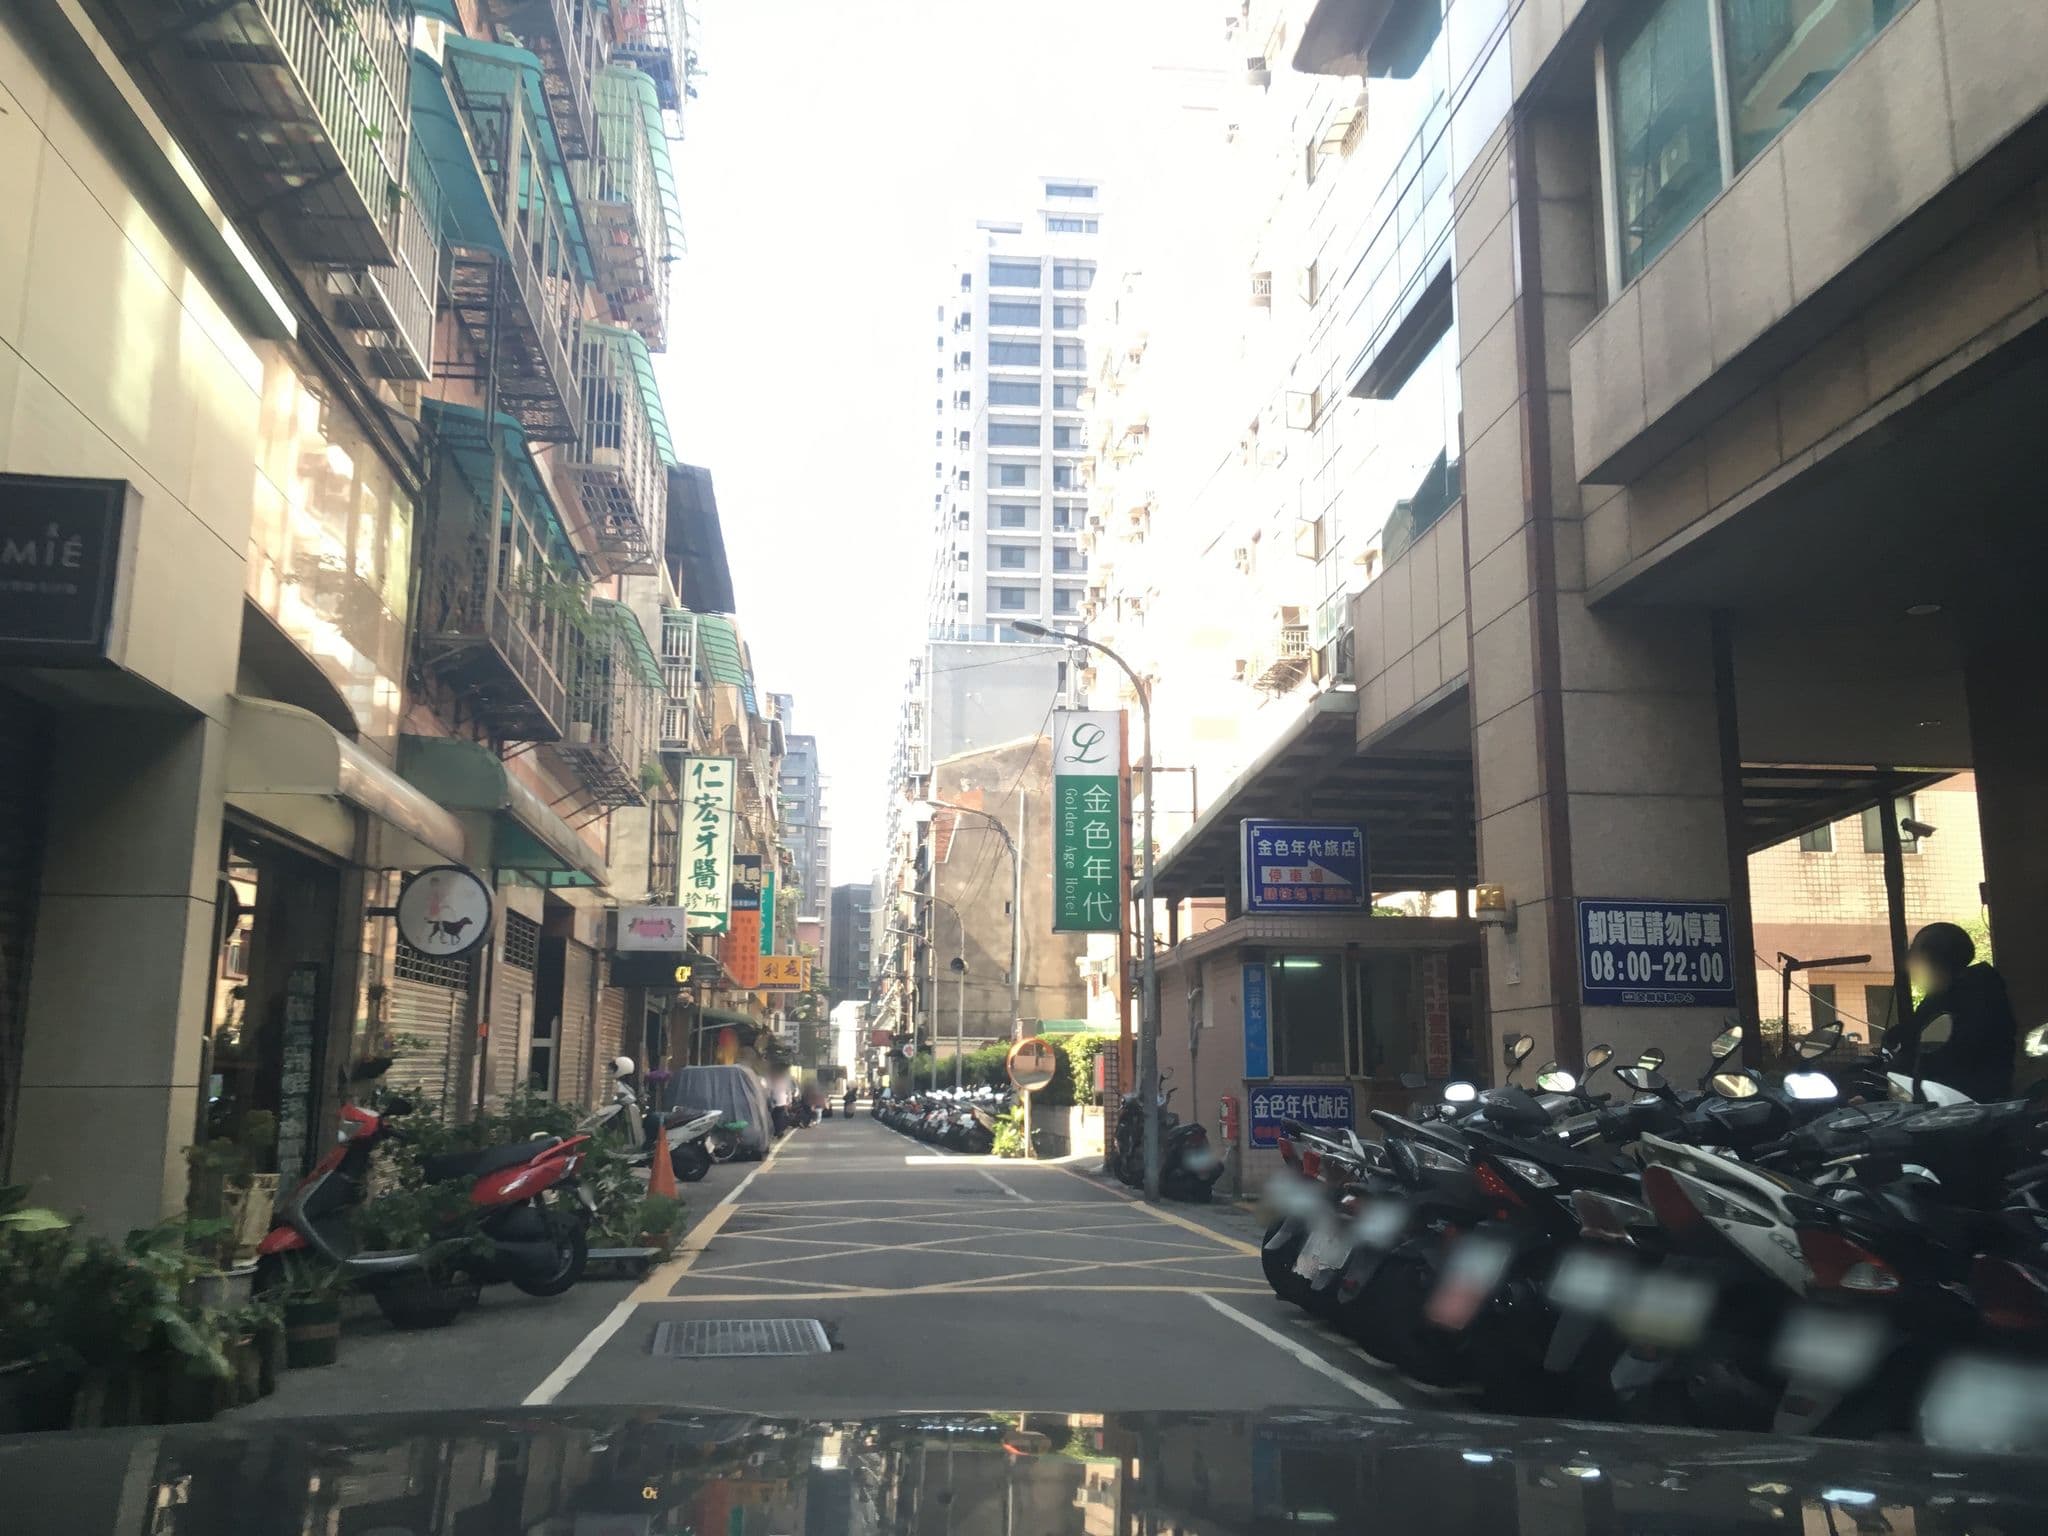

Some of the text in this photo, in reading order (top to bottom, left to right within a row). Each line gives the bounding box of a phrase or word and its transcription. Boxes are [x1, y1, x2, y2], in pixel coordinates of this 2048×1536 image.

[688, 762, 724, 890] 仁宏牙醫
[1064, 788, 1078, 916] Golden Age Hotel
[1082, 784, 1112, 922] 金色年代
[1257, 839, 1356, 857] 金色年代旅店
[684, 893, 721, 910] 診所
[1588, 910, 1722, 946] 卸貨區請勿停車
[1591, 950, 1724, 982] 08:00-22:00
[1253, 1094, 1349, 1119] 金色年代旅店
